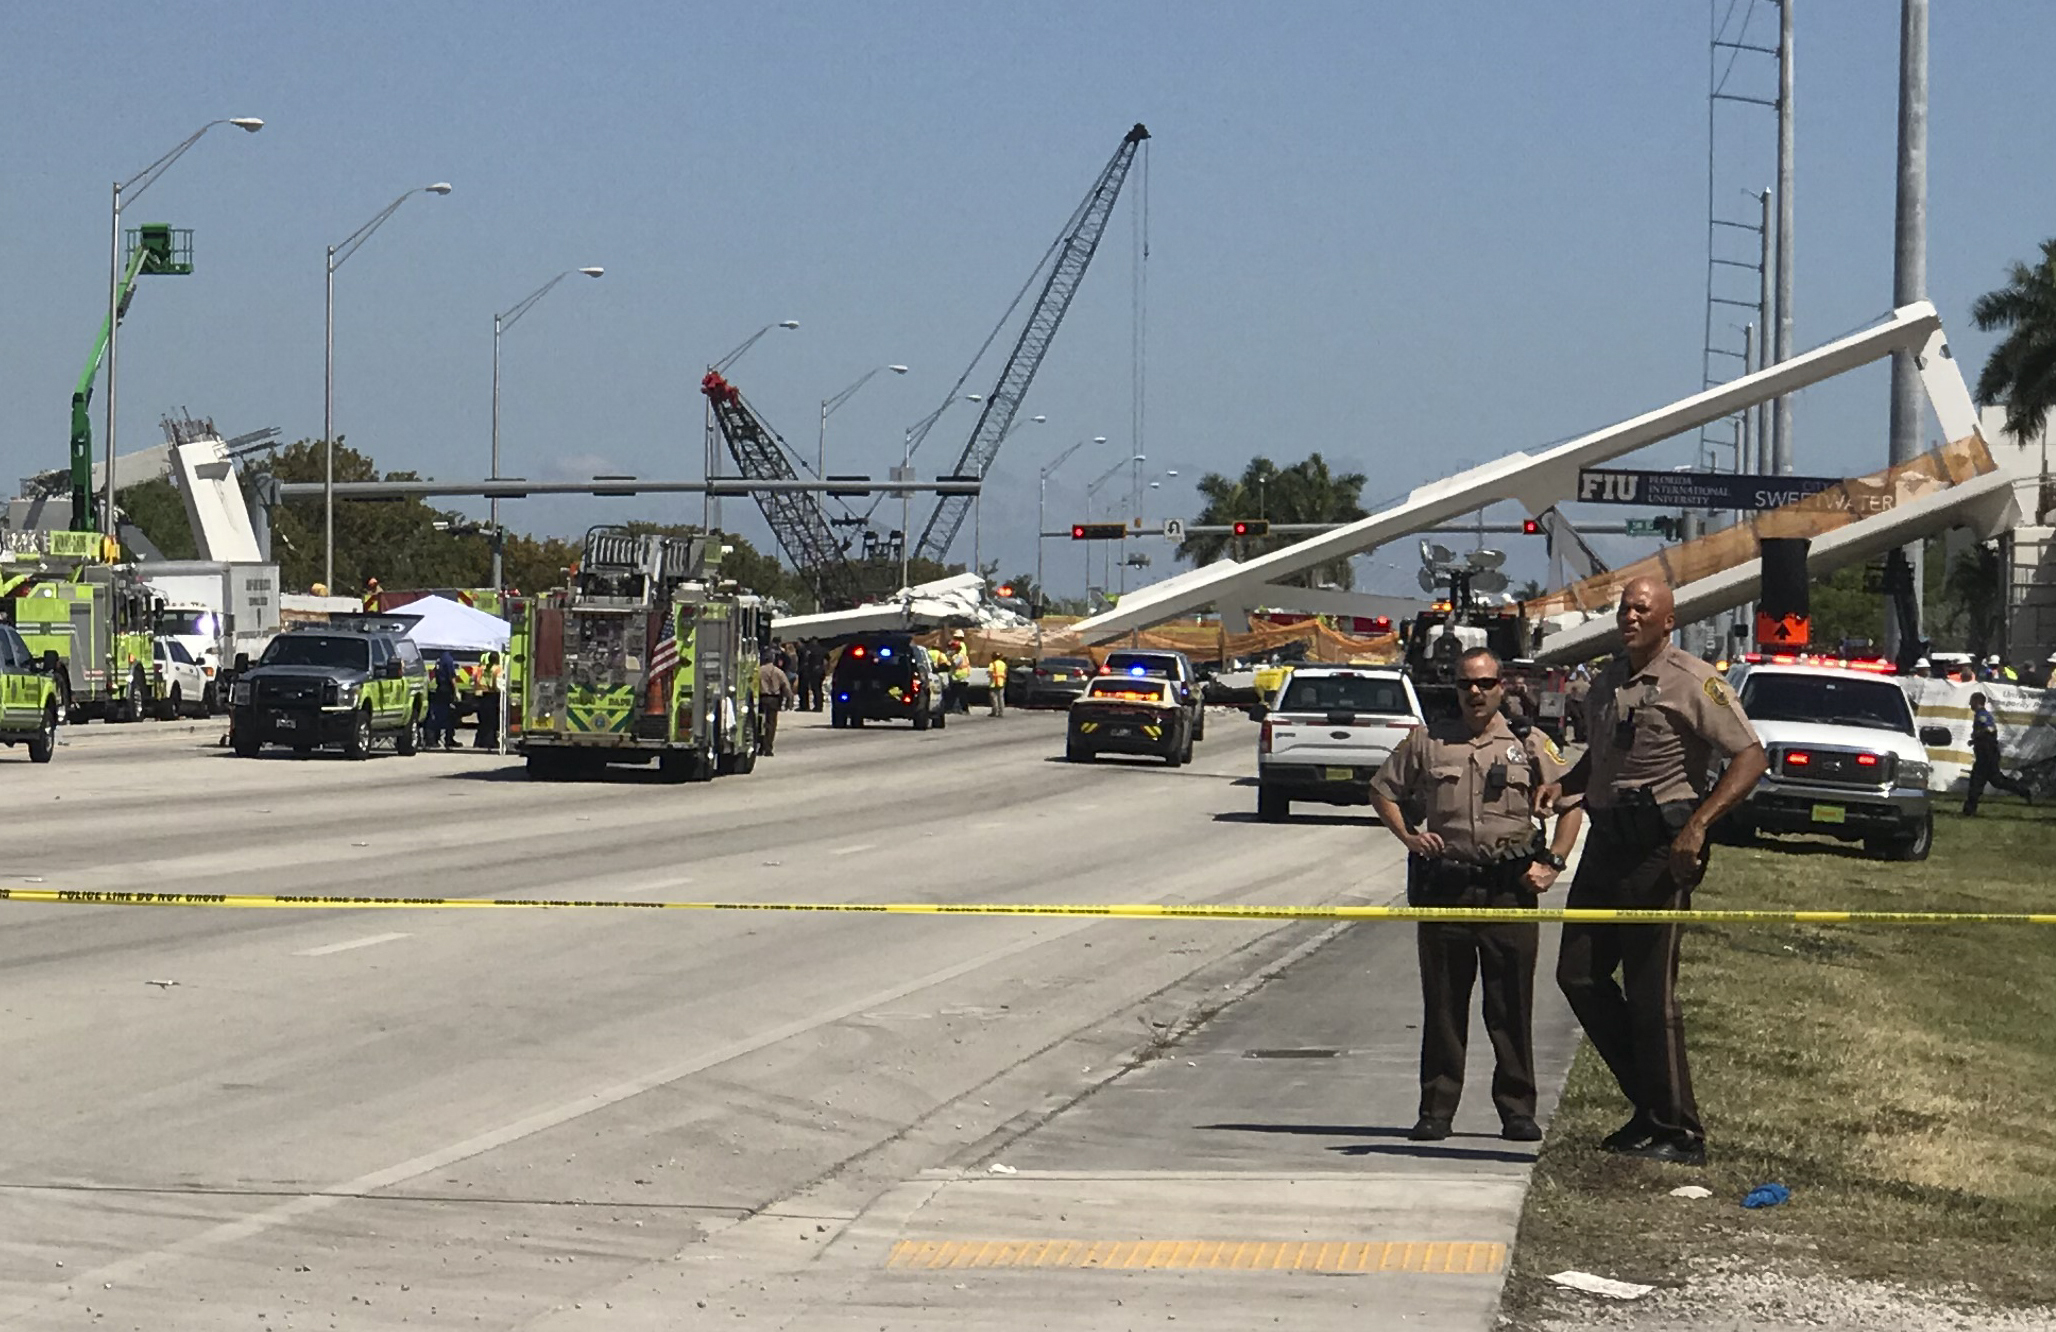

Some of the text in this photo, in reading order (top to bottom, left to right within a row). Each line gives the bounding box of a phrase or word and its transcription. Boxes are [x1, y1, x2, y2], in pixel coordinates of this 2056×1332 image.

[1649, 476, 1692, 484] FLORIDA
[1581, 473, 1639, 500] FIU
[1649, 485, 1729, 496] INTERNATIONAL
[1648, 494, 1710, 504] UNIVERSITY
[58, 890, 102, 900] POLICE
[106, 892, 133, 901] LINE
